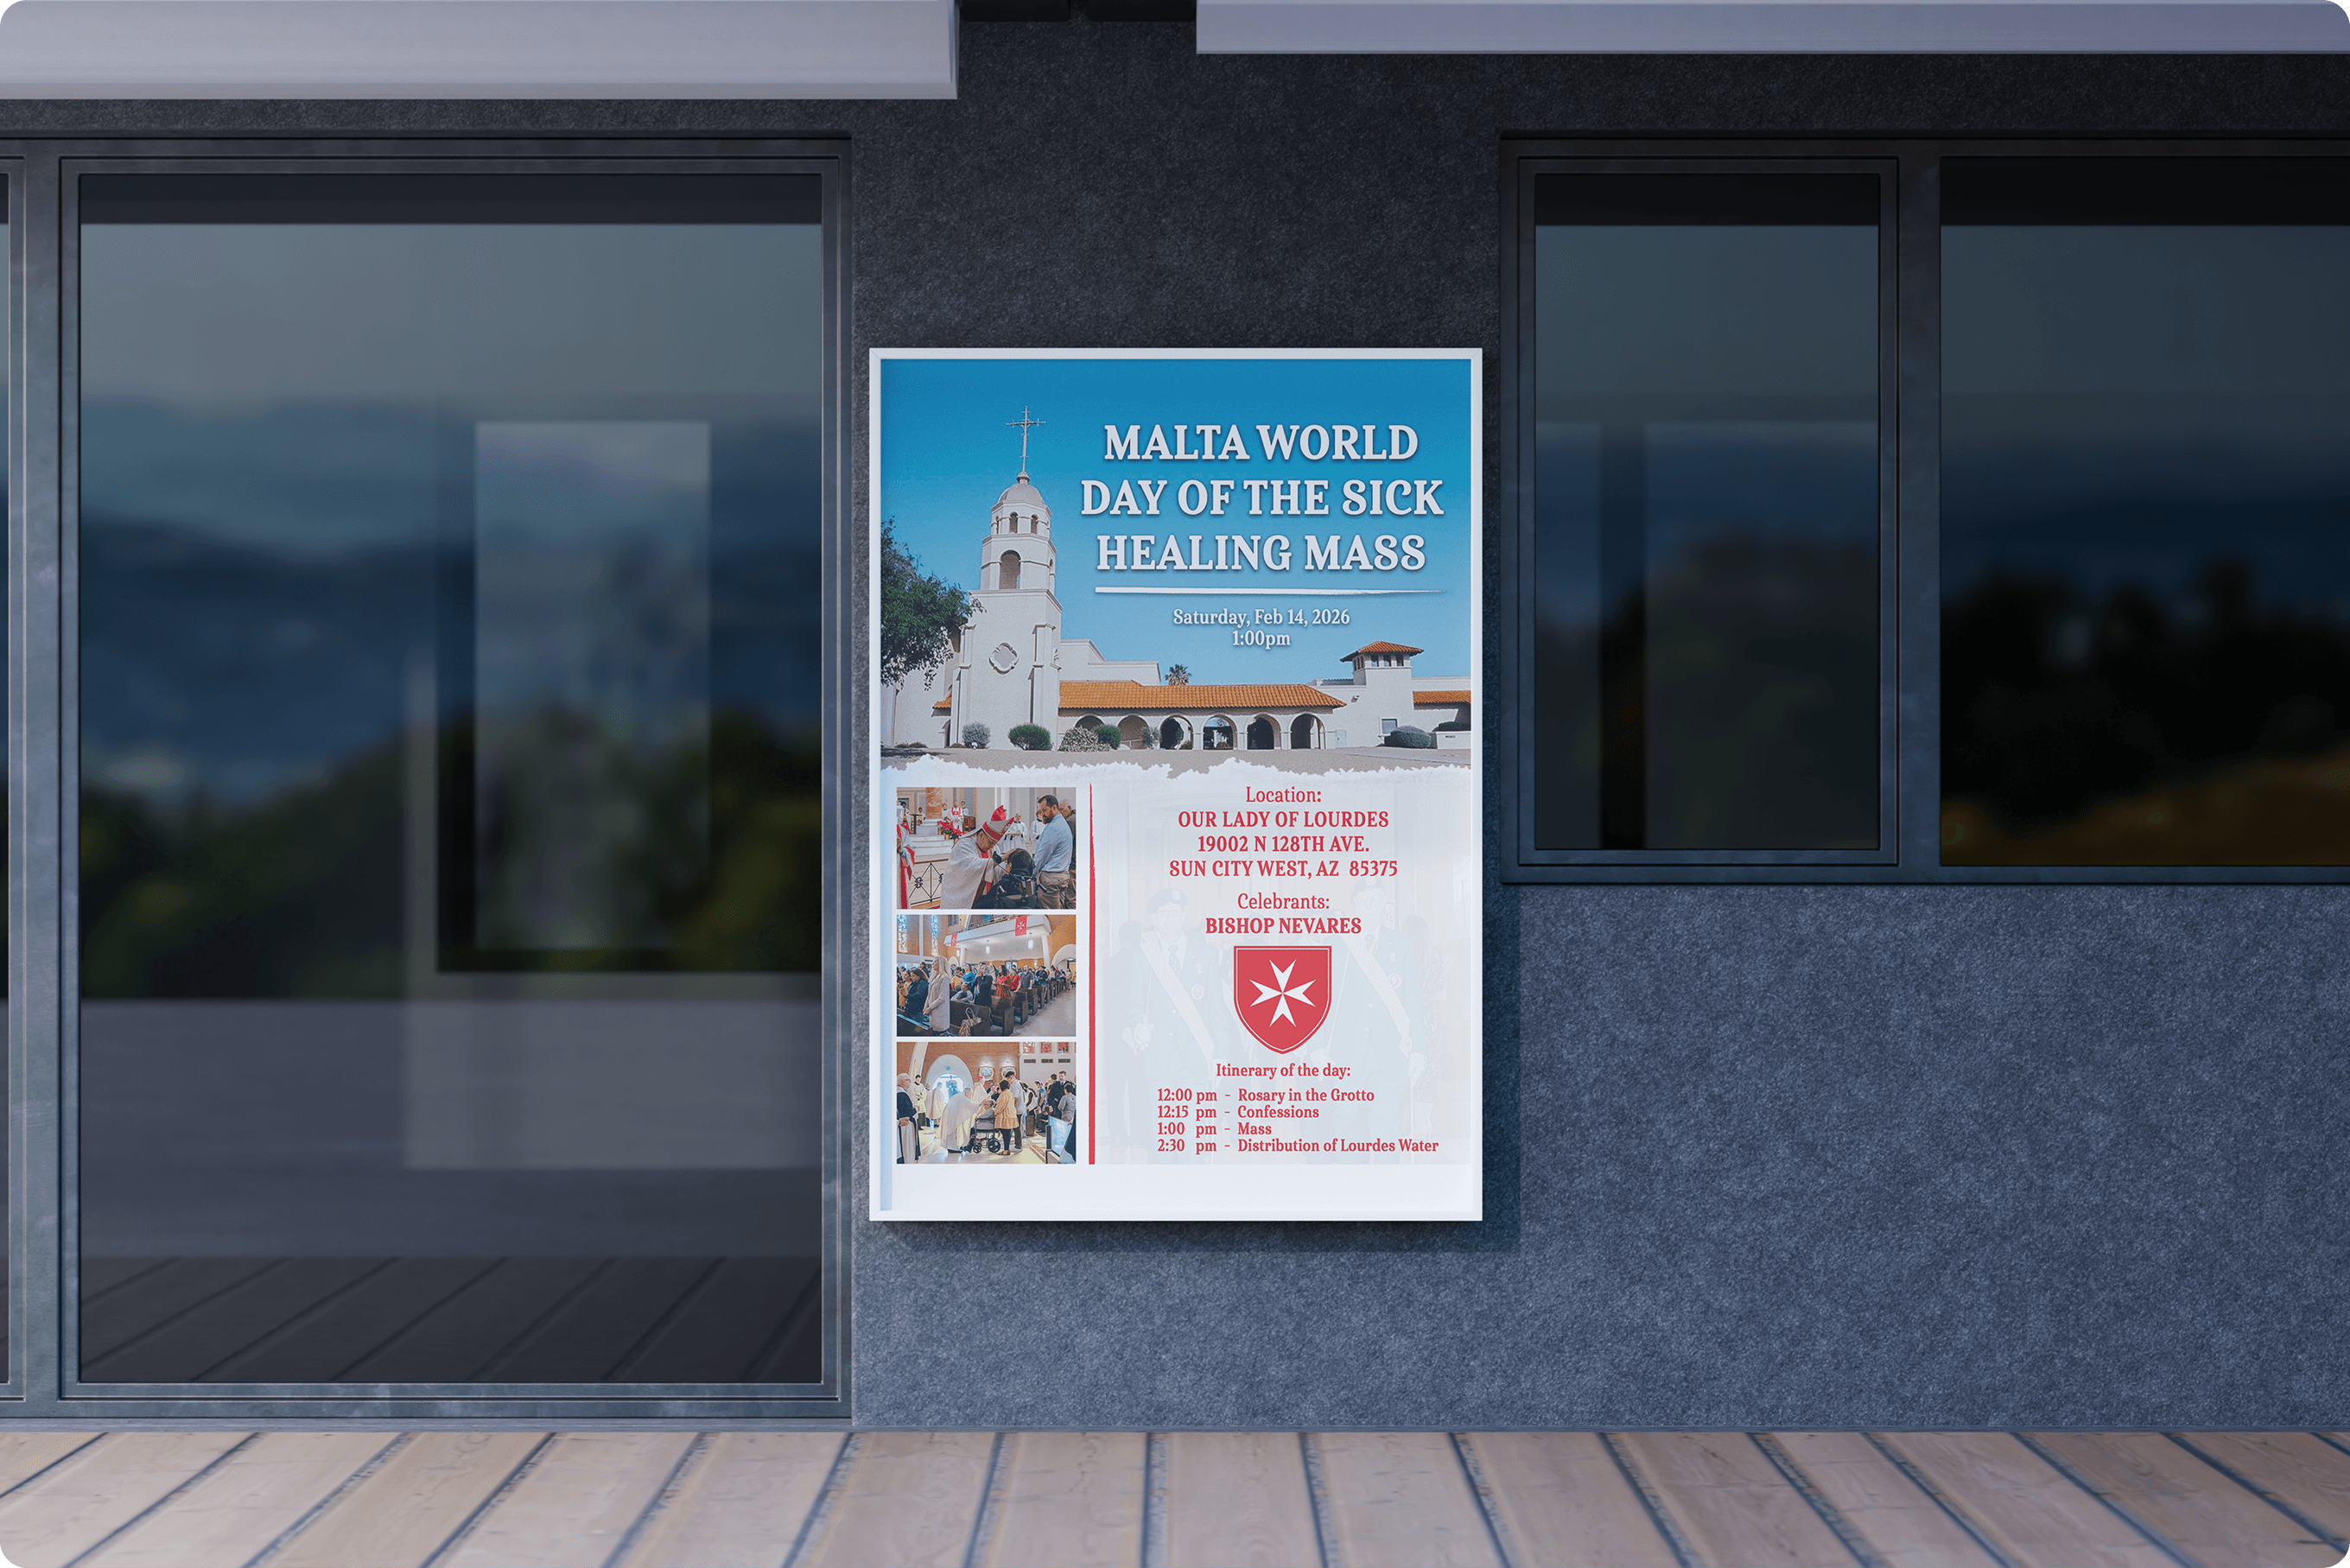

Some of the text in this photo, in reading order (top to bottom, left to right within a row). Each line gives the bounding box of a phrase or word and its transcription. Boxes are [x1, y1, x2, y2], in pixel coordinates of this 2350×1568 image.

[1104, 424, 1419, 460] MALTA WORLD
[1081, 479, 1445, 516] DAY OF THE SICK
[1096, 534, 1426, 572] HEALING MASS
[1173, 607, 1350, 629] Saturday, Feb 14, 2026
[1232, 630, 1291, 651] 1:00pm
[1246, 785, 1322, 803] Location:
[1178, 810, 1389, 828] OUR LADY OF LOURDES
[1197, 835, 1370, 853] 19002 N 128TH AVE.
[1169, 860, 1398, 880] SUN CITY WEST, AZ 85375
[1237, 892, 1330, 910] Celebrants:
[1205, 917, 1362, 934] BISHOP NEVARES
[1216, 1062, 1351, 1081] Itinerary of the day:
[1157, 1088, 1193, 1101] 12:00
[1196, 1091, 1218, 1105] pm
[1238, 1088, 1286, 1105] Rosary
[1288, 1088, 1303, 1101] in
[1305, 1087, 1328, 1101] the
[1331, 1088, 1375, 1101] Grotto
[1157, 1105, 1189, 1119] 12:15
[1195, 1108, 1217, 1122] pm
[1237, 1104, 1319, 1119] Confessions
[1157, 1121, 1185, 1135] 1:00
[1195, 1125, 1217, 1139] pm
[1237, 1121, 1273, 1135] Mass
[1157, 1138, 1185, 1152] 2:30
[1195, 1142, 1217, 1155] pm
[1237, 1138, 1320, 1152] Distribution
[1323, 1138, 1339, 1152] of
[1340, 1138, 1396, 1152] Lourdes
[1398, 1138, 1440, 1152] Water
